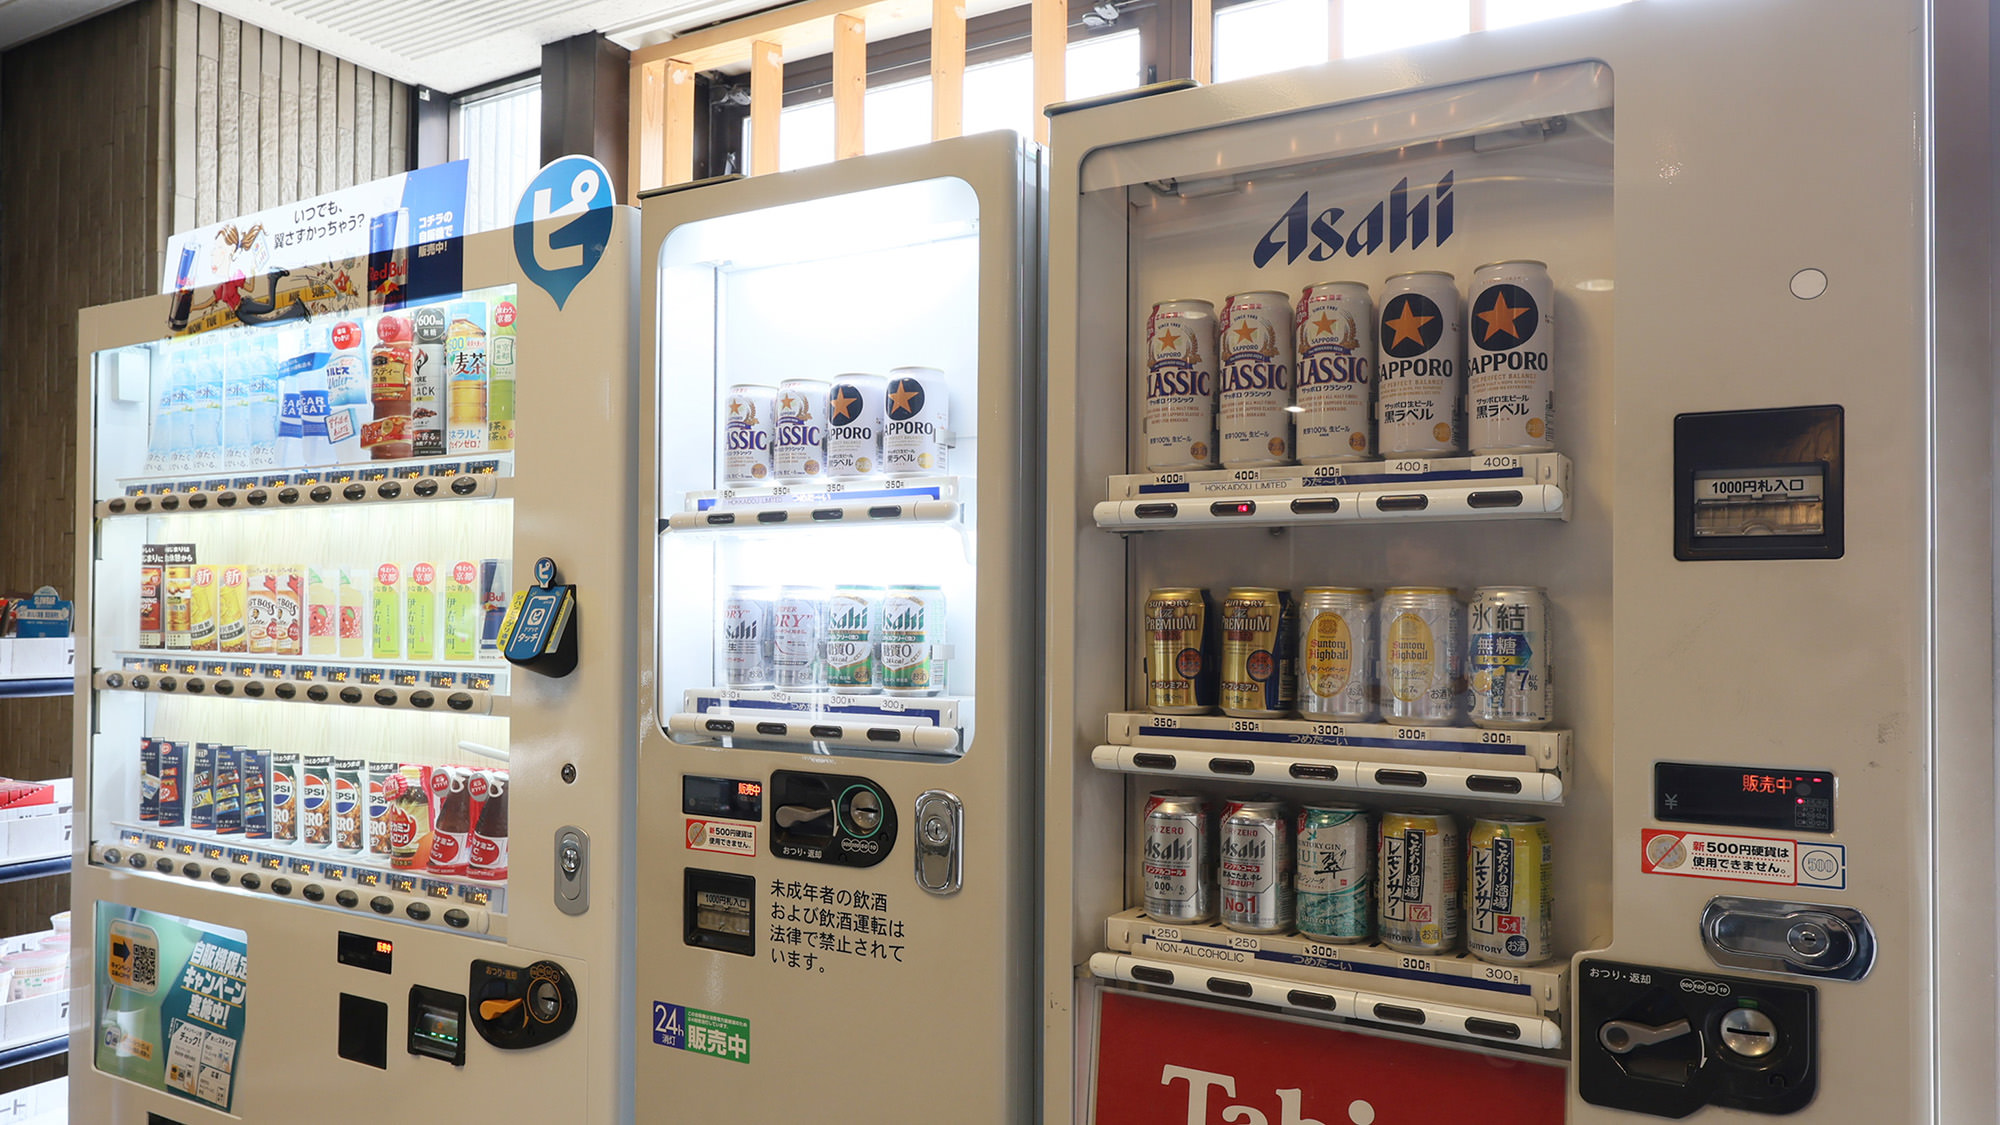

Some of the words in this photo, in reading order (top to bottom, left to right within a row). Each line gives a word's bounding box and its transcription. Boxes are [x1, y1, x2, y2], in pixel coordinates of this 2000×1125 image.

[294, 200, 343, 224] いつでも、
[1253, 169, 1454, 269] Asahi
[418, 211, 453, 229] コチラの
[1232, 344, 1259, 352] SAPPORO
[1311, 337, 1339, 345] SAPPORO
[1156, 351, 1182, 360] SAPPORO
[455, 351, 487, 375] 麦茶
[1243, 390, 1272, 398] クラシック
[1323, 384, 1352, 392] クラシック
[1167, 396, 1194, 404] クラシック
[1384, 401, 1434, 410] サッポロ生ビール
[1476, 395, 1529, 404] サッポロ生ビール
[1384, 408, 1434, 424] 黒ラベル
[1476, 403, 1530, 419] 黒ラベル
[1248, 430, 1270, 438] 生ビール
[1329, 425, 1351, 434] 生ビール
[1172, 434, 1192, 443] 生ビール
[887, 454, 916, 463] 黒ラベル
[1483, 456, 1518, 468] 400円
[1314, 466, 1340, 477] 400円
[1395, 461, 1429, 472] 400円
[1234, 470, 1259, 480] 400円
[1204, 483, 1252, 492] HOKKAIDOU
[1255, 481, 1287, 490] LIMITED
[1712, 479, 1804, 494] 1000円札入口
[196, 568, 212, 586] 新
[225, 568, 241, 586] 新
[1149, 599, 1190, 608] SUNTORY
[1145, 615, 1196, 631] PREMIUM
[1472, 604, 1527, 632] 氷結
[518, 632, 539, 643] タッチ
[1310, 639, 1346, 649] Suntory
[1393, 641, 1425, 651] Suntory
[1477, 637, 1517, 655] 無糖
[1308, 648, 1349, 662] Highball
[1391, 650, 1428, 662] Highball
[1482, 656, 1512, 664] レモン
[1517, 670, 1529, 690] 7
[1153, 717, 1177, 728] 350円
[1235, 721, 1260, 732] 350円
[1318, 725, 1344, 736] 300円
[1398, 728, 1426, 740] 300円
[1482, 732, 1512, 744] 300円
[738, 782, 761, 796] 販売中
[1742, 774, 1793, 795] 販売中
[1664, 793, 1678, 810] ¥
[709, 826, 753, 839] 新500円硬貨は
[1160, 826, 1184, 835] ZERO
[1237, 828, 1258, 837] ZERO
[709, 837, 752, 849] 使用できません。
[1144, 836, 1193, 861] Asahi
[1221, 837, 1266, 859] Asahi
[1324, 843, 1341, 851] GIN
[1692, 840, 1789, 858] 新500円硬貨は
[782, 846, 823, 859] おつり・返却
[1146, 866, 1184, 876] ノンアルコール
[1315, 849, 1347, 879] 翠
[1406, 832, 1424, 899] こだわり酒場
[1692, 856, 1787, 874] 使用できません。
[1807, 857, 1834, 873] 500
[1387, 840, 1402, 917] レモンサワー
[1493, 841, 1510, 910] こだわり酒場
[771, 879, 887, 912] 未成年者の飲酒
[1475, 850, 1491, 929] レモンサワー
[705, 893, 747, 909] 1000円札入口
[1225, 895, 1257, 915] No.1
[771, 902, 905, 938] および飲酒運転は
[1412, 907, 1430, 920] 7度
[1498, 918, 1519, 933] 5度
[1421, 930, 1440, 940] お酒
[770, 923, 905, 962] 法律で禁止されて
[1228, 938, 1257, 949] ¥250
[1506, 939, 1528, 953] お酒
[1155, 941, 1245, 963] NON-ALCOHOLIC
[1311, 945, 1337, 958] 300円
[772, 948, 825, 973] います。
[1403, 958, 1431, 971] 300円
[1485, 967, 1520, 985] 300円
[1589, 967, 1652, 985] おつり・返却
[182, 966, 247, 1005] キャンペーン
[187, 993, 231, 1027] 実施中!
[655, 1004, 684, 1037] 24h
[688, 1024, 747, 1059] 販売中
